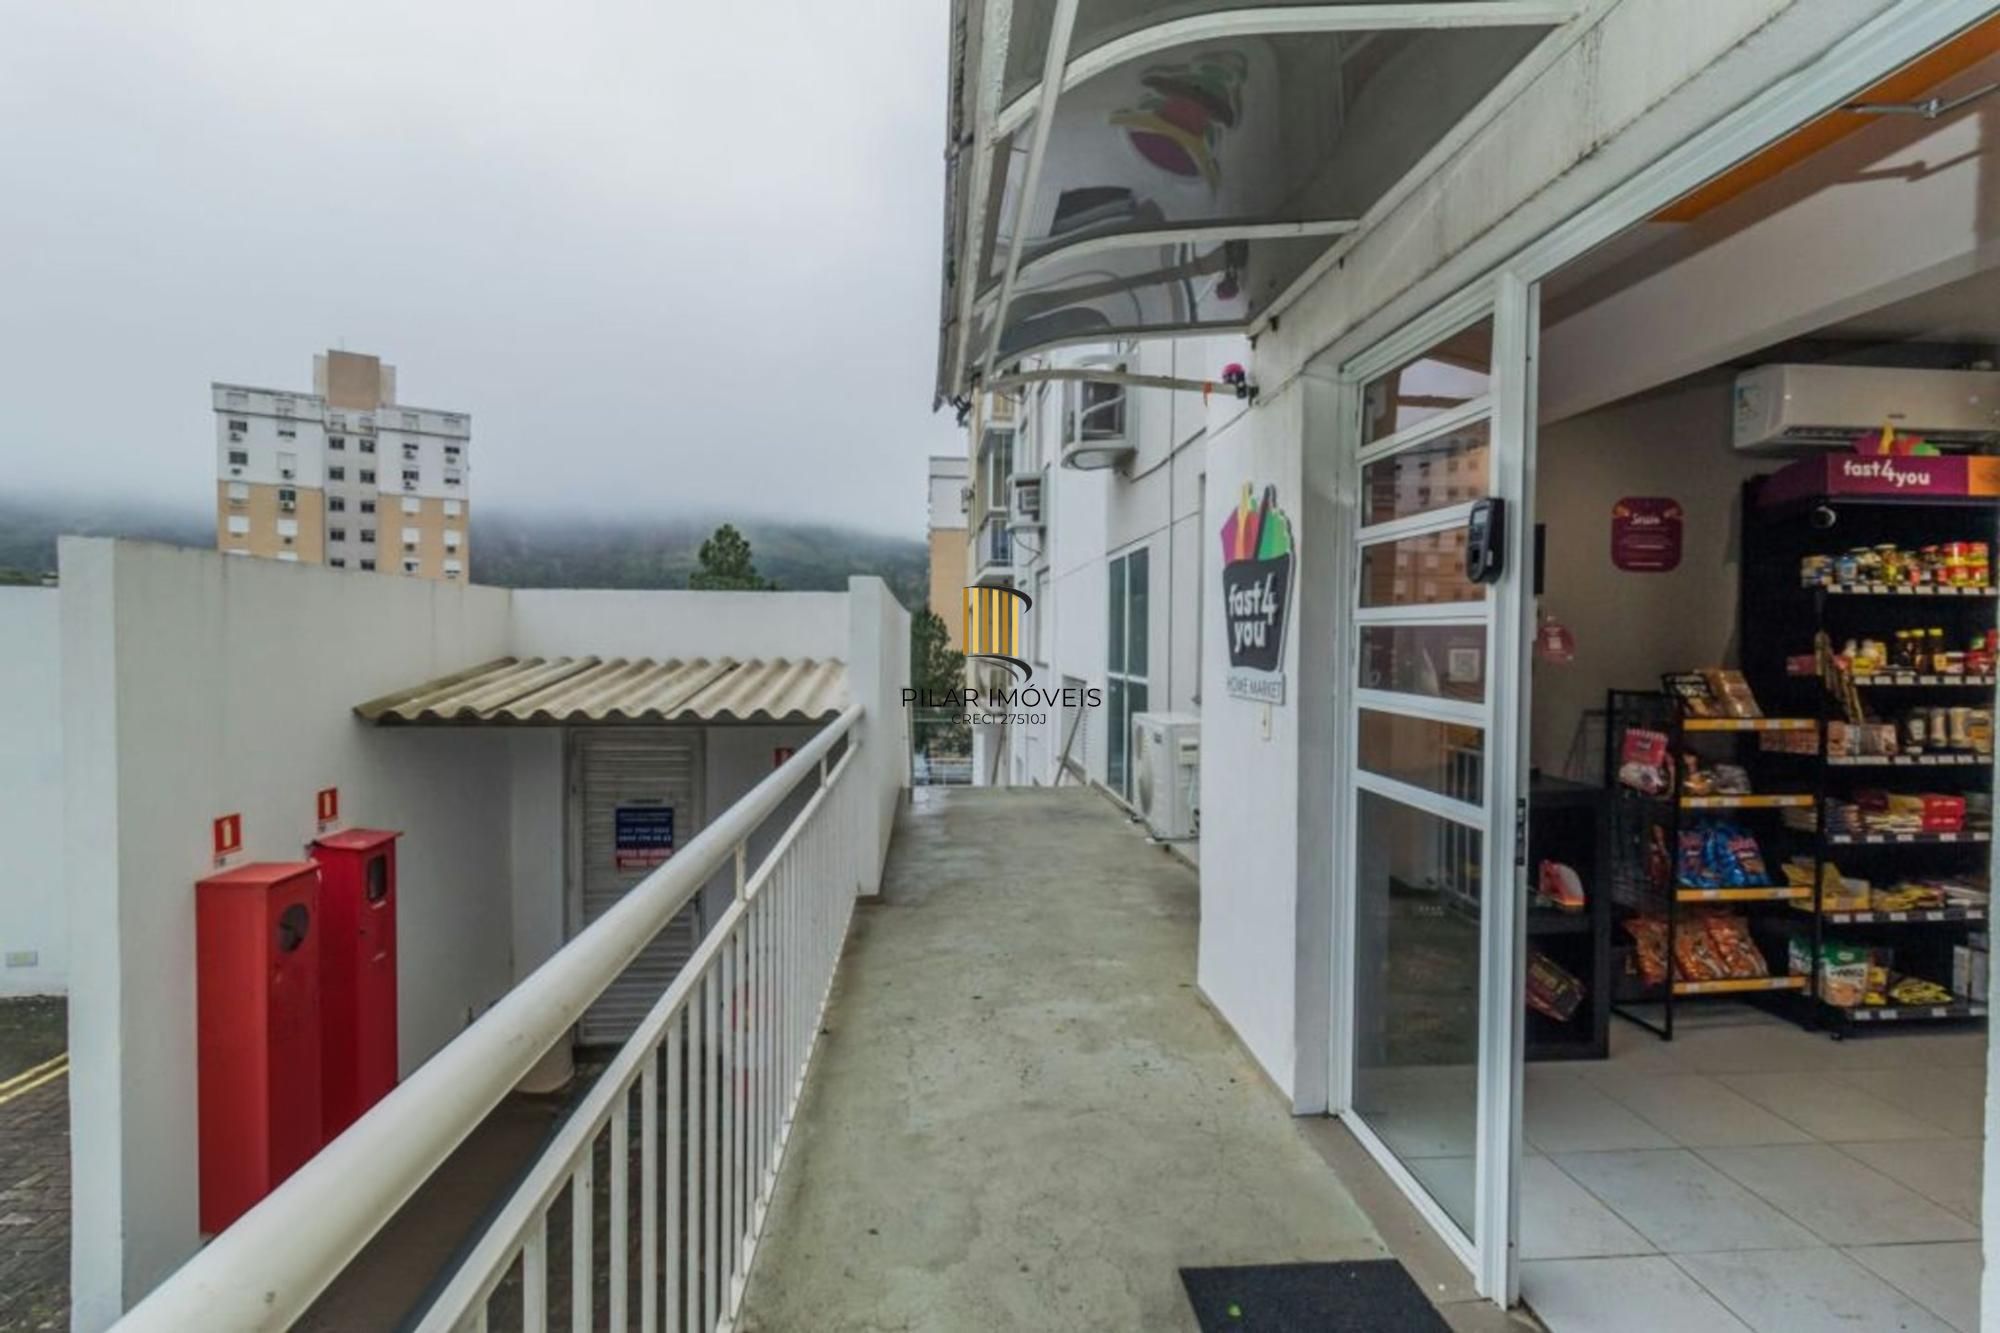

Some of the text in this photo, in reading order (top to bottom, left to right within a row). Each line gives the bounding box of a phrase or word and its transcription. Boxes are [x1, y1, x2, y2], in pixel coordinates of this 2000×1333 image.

[1843, 459, 1931, 488] fast4you
[1228, 571, 1278, 626] fast4
[1233, 620, 1266, 654] you
